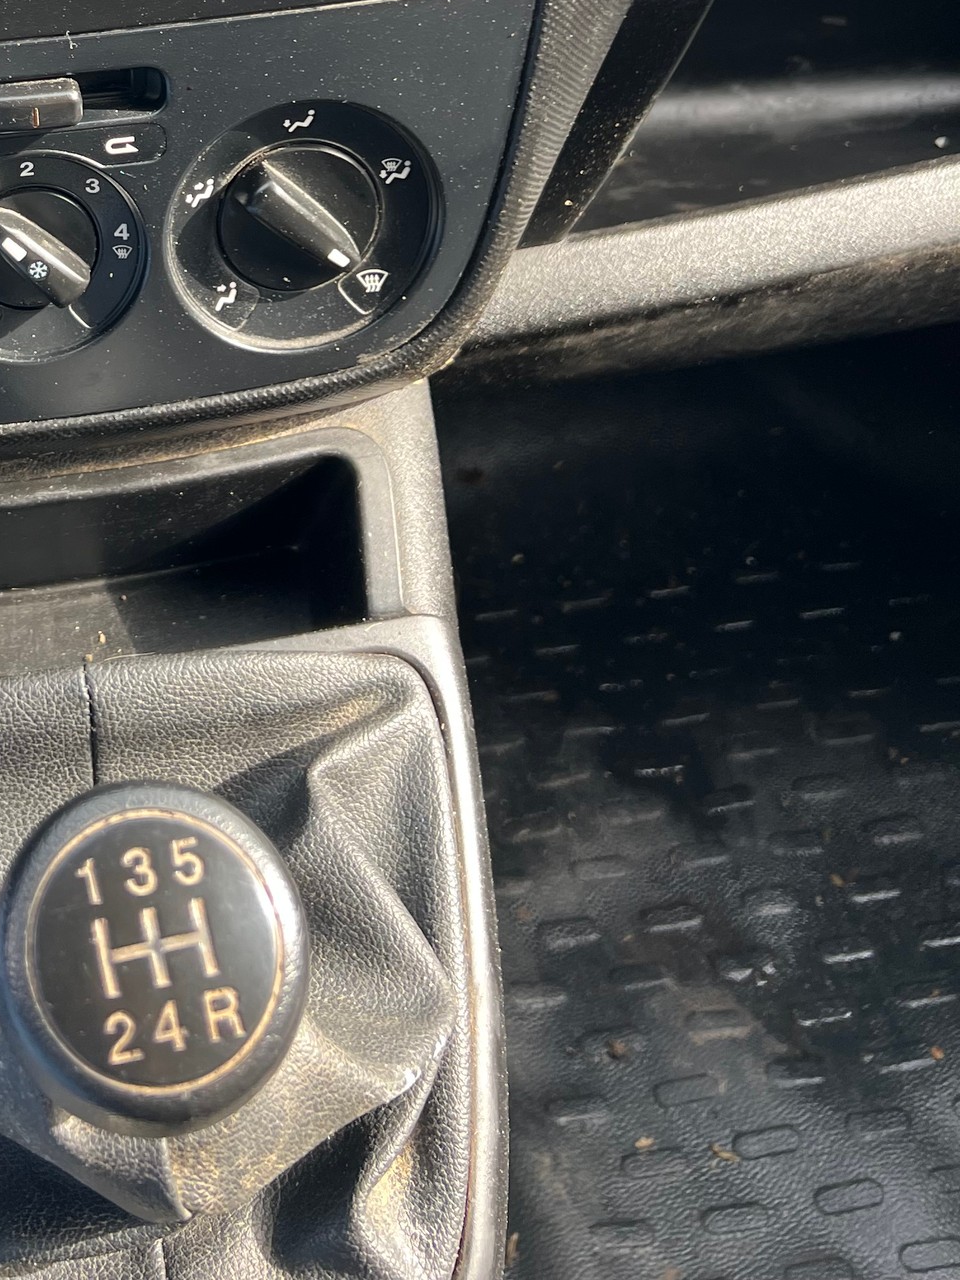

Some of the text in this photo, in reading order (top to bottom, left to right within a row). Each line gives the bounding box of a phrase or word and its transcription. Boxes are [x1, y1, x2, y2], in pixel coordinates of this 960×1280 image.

[19, 161, 35, 177] 2
[85, 178, 101, 194] 3
[113, 223, 130, 240] 4
[75, 836, 205, 905] 1 3 5
[104, 986, 247, 1066] 2 4 R
